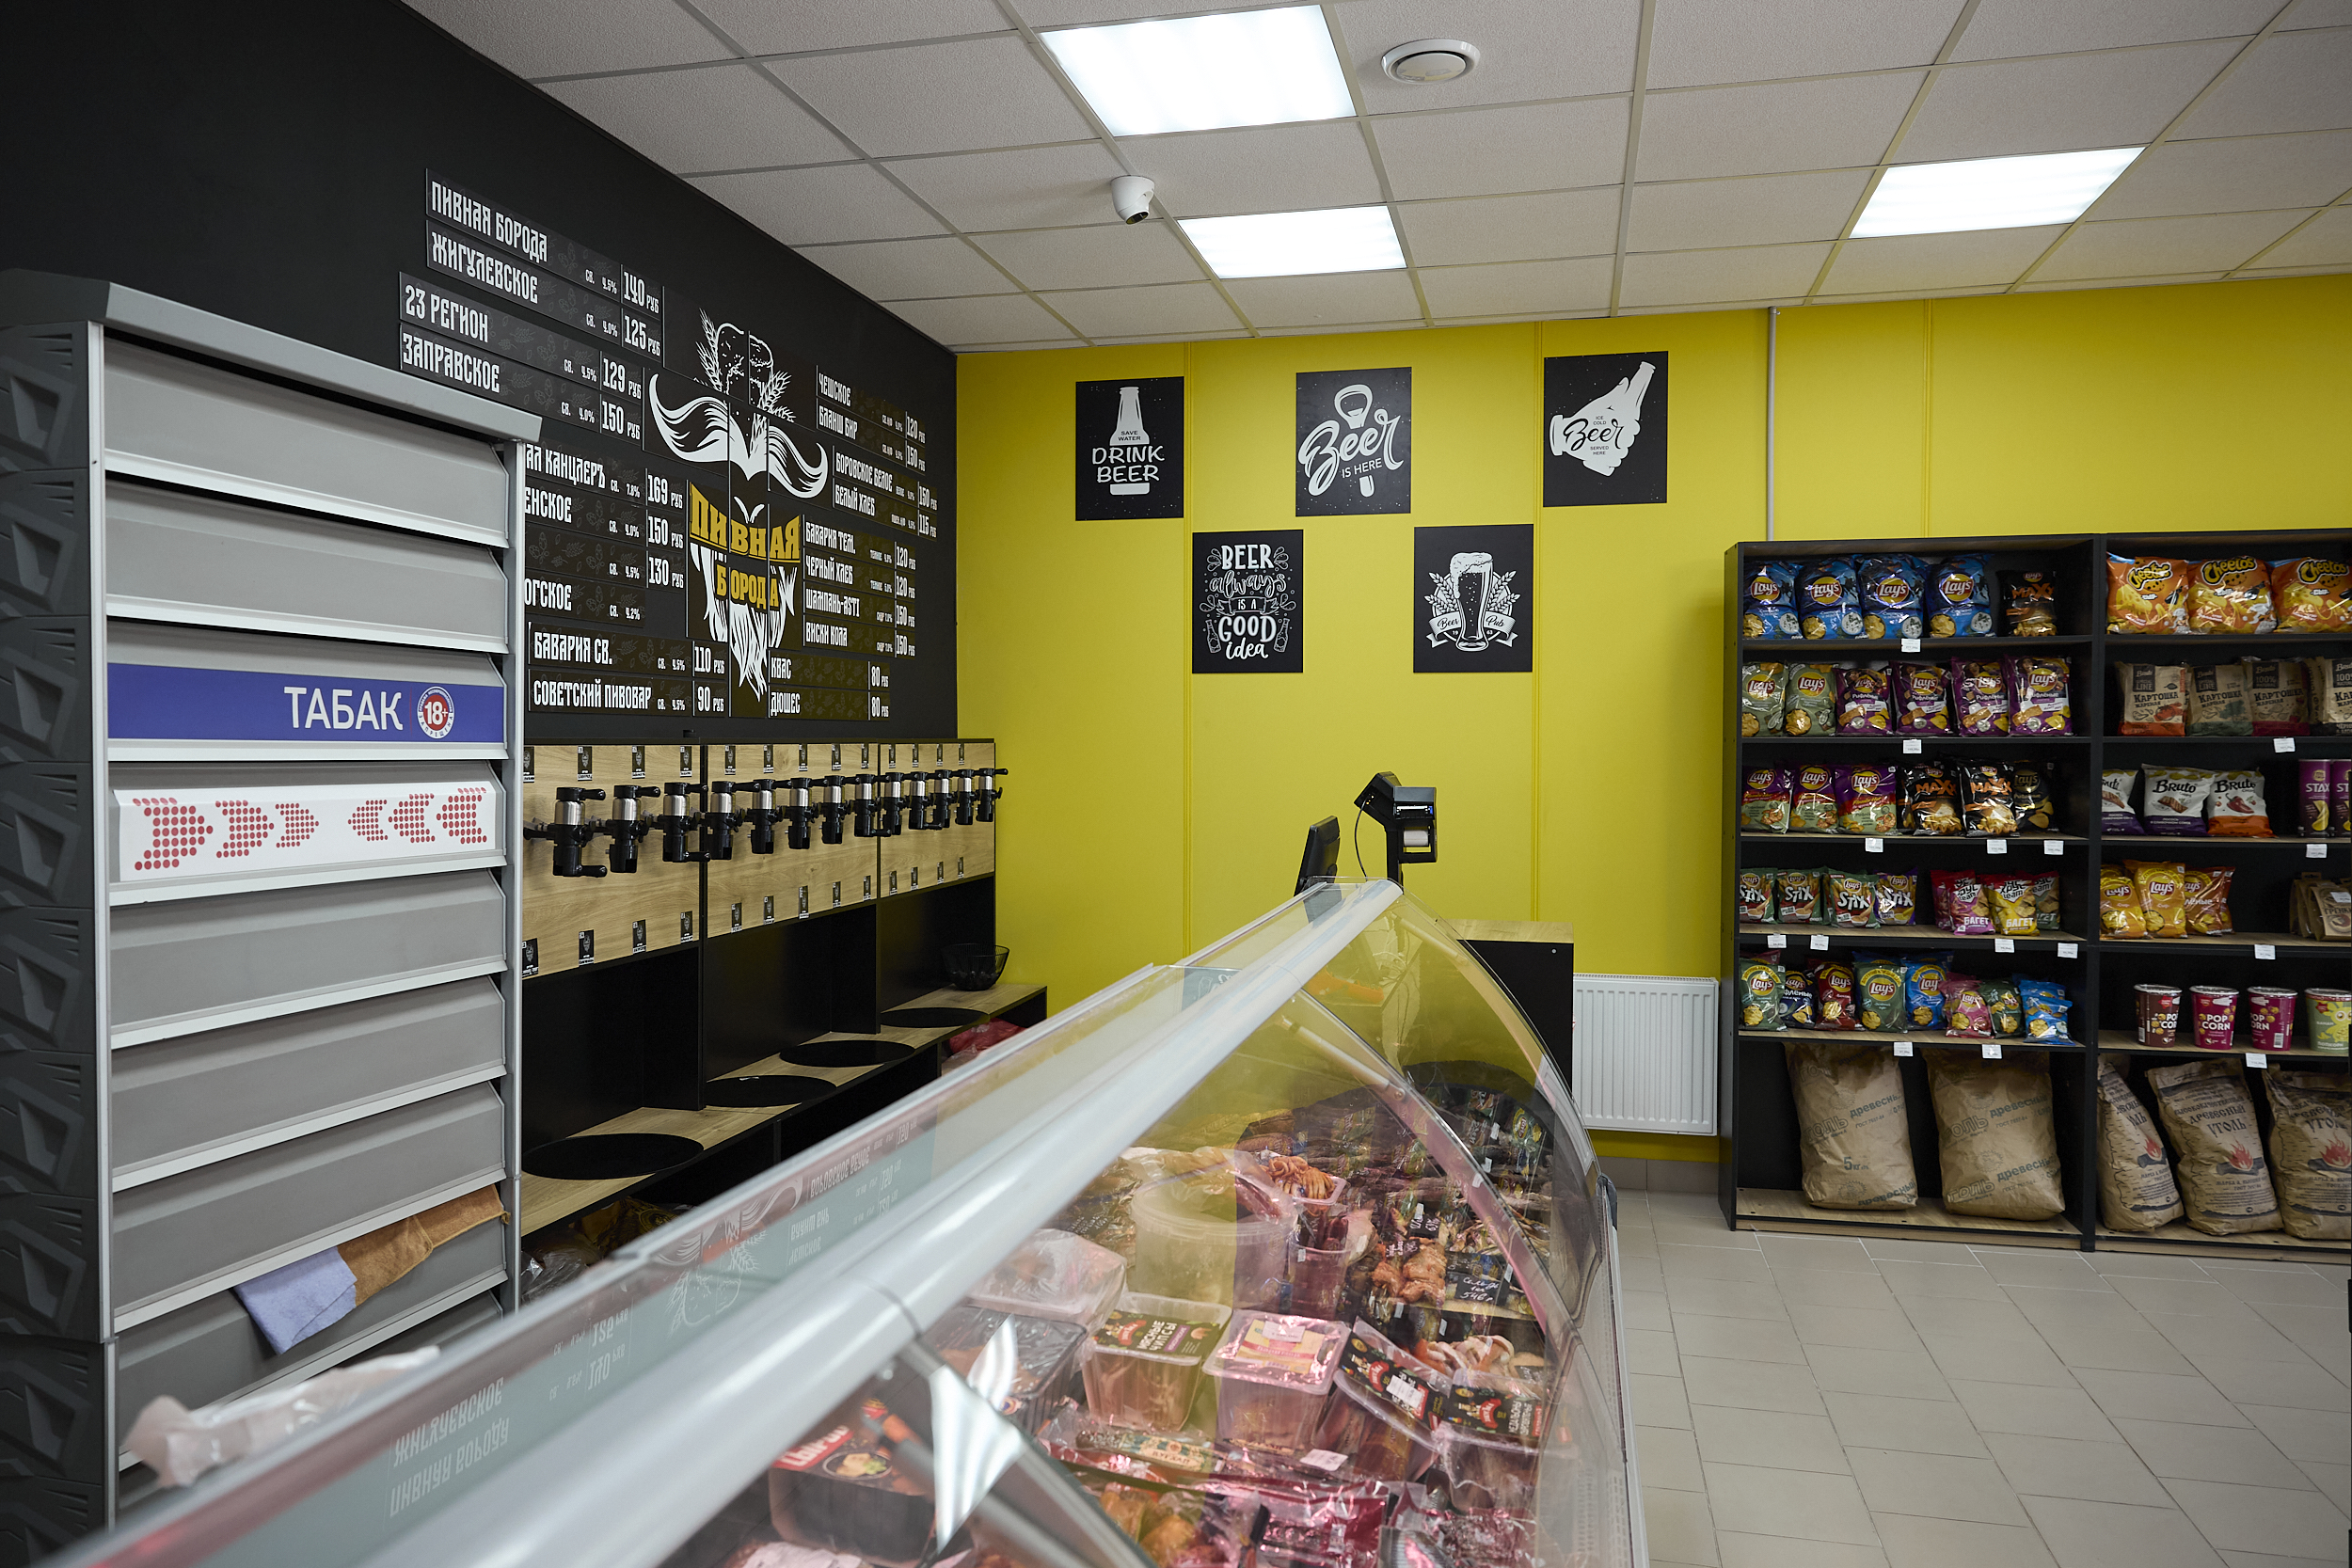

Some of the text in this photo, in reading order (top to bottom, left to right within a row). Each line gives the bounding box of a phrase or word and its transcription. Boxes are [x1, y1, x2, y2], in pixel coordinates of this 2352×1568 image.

[432, 181, 491, 236] ПИВНАЯ
[496, 212, 548, 263] БОРОДА
[624, 271, 644, 307] 140
[646, 293, 659, 314] РУБ
[432, 231, 538, 304] ЖИГУЛЕВСКОЕ
[625, 315, 646, 350] 125
[648, 337, 660, 356] РУБ
[405, 285, 425, 319] 23
[430, 294, 488, 342] РЕГИОН
[603, 358, 626, 392] 129
[628, 380, 642, 399] РУБ
[403, 333, 500, 393] ЗАПРАВСКОЕ
[602, 401, 624, 435] 150
[627, 421, 641, 440] РУБ
[818, 372, 851, 407] ЧЕШСКОЕ
[907, 416, 918, 439] 120
[818, 405, 844, 435] БЛАНШ
[907, 445, 918, 467] 150
[1563, 418, 1625, 451] Beer
[1092, 445, 1166, 465] DRINK
[1298, 408, 1404, 497] Beer
[546, 449, 606, 489] КАНЦЛЕРЪ
[648, 474, 668, 505] 169
[671, 492, 683, 509] РУБ
[835, 451, 873, 484] БОРОВСКОЕ
[874, 469, 893, 492] БЕЛОЕ
[1097, 465, 1160, 483] BEER
[1342, 457, 1383, 479] IS HERE
[835, 483, 858, 511] БЕЛЫЙ
[859, 493, 876, 516] ХЛЕБ
[648, 516, 669, 546] 150
[671, 532, 683, 549] РУБ
[690, 482, 801, 561] ПИВНАЯ
[805, 522, 837, 549] БАВАРИЯ
[896, 546, 908, 568] 120
[1221, 544, 1274, 570] BEER
[648, 557, 669, 586] 130
[672, 572, 684, 589] РУБ
[805, 553, 834, 580] ЧЕРНЫЙ
[835, 563, 853, 585] ХЛЕБ
[896, 575, 908, 597] 120
[2203, 559, 2255, 582] Cheetos
[2300, 561, 2348, 582] Cheetos
[716, 563, 779, 610] БОРОДА
[1209, 569, 1287, 598] always
[1754, 581, 1777, 595] Lay's
[1814, 582, 1839, 597] Lay's
[1882, 584, 1907, 598] Lay's
[1945, 580, 1972, 595] Lay's
[896, 605, 908, 626] 150
[1250, 599, 1257, 610] A
[1217, 615, 1277, 642] GOOD
[1486, 615, 1505, 627] Pub
[805, 622, 829, 645] ВИСКИ
[830, 625, 848, 647] КОЛА
[896, 634, 908, 656] 150
[1225, 637, 1269, 659] idea
[533, 631, 725, 674] БАВАРИЯ СВ. 110 РУБ
[771, 657, 792, 680] КВАС
[871, 666, 881, 688] 80
[1800, 677, 1824, 691] Lay's
[1914, 677, 1936, 690] Lay's
[2030, 673, 2056, 687] Lay's
[533, 678, 724, 712] СОВЕТСКИЙ ПИВОВАР 90 РУБ
[771, 691, 801, 717] ДЮШЕС
[871, 696, 881, 718] 80
[284, 686, 404, 731] ТАБАК
[424, 701, 449, 725] 18+
[1749, 771, 1772, 784] Lay's
[1802, 772, 1826, 784] Lay's
[1853, 776, 1877, 787] Lay's
[2151, 882, 2173, 895] Lay's
[2006, 918, 2033, 927] БАГЕТ
[1752, 978, 1772, 990] Lay's
[1831, 975, 1851, 988] Lay's
[1870, 983, 1895, 995] Lay's
[2202, 1022, 2230, 1030] CORN
